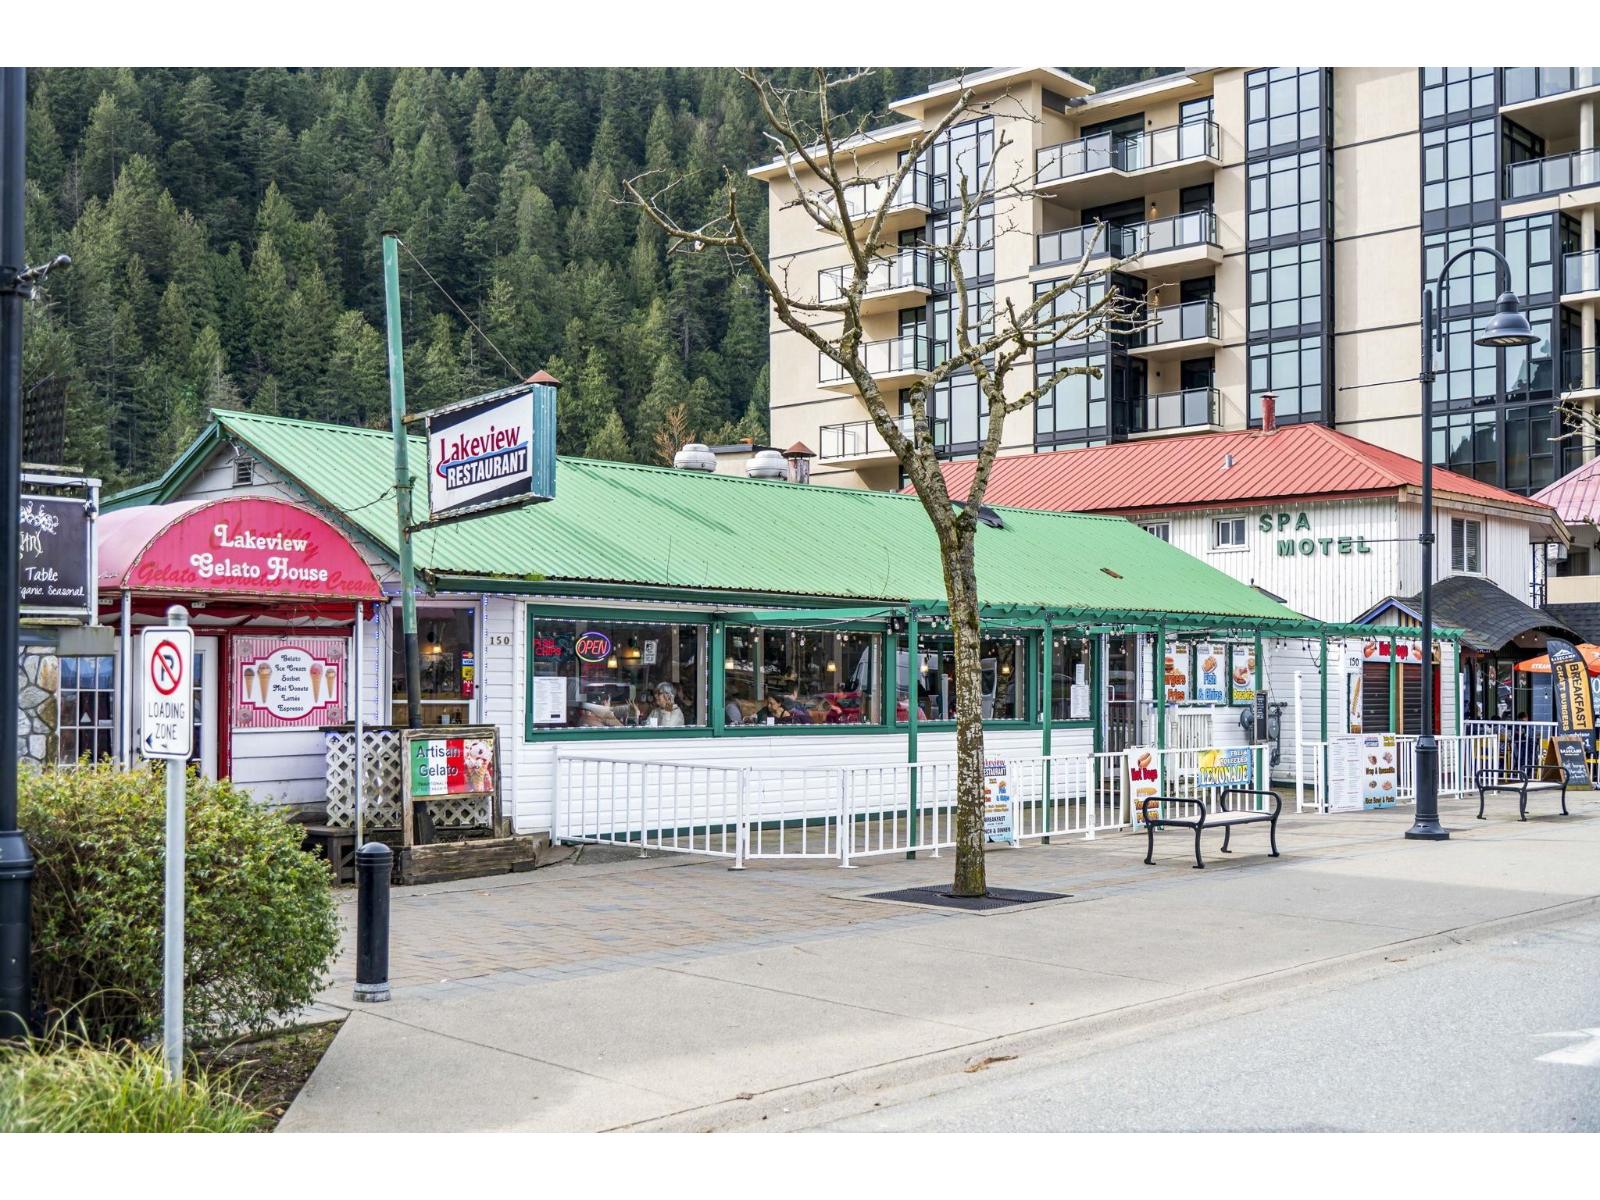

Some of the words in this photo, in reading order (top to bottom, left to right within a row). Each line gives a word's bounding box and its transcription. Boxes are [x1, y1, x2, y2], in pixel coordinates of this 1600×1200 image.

[440, 425, 520, 465] Lakeview
[447, 450, 526, 488] RESTAURANT
[1259, 512, 1311, 533] SPA
[214, 524, 308, 552] Lakeview
[1276, 536, 1371, 556] MOTEL
[25, 566, 59, 582] Table
[190, 553, 261, 577] Gelato
[267, 556, 328, 582] House
[47, 585, 85, 597] Seasonal
[490, 636, 510, 646] 150
[577, 640, 608, 655] OPEN
[1349, 658, 1360, 667] 150
[1569, 663, 1587, 728] BREAKFAST
[148, 702, 185, 719] LOADING
[1561, 693, 1570, 731] BURGERS
[155, 723, 177, 740] ZONE
[416, 745, 461, 758] Artisan
[419, 764, 459, 777] Gelato
[1199, 765, 1249, 785] LEMONADE
